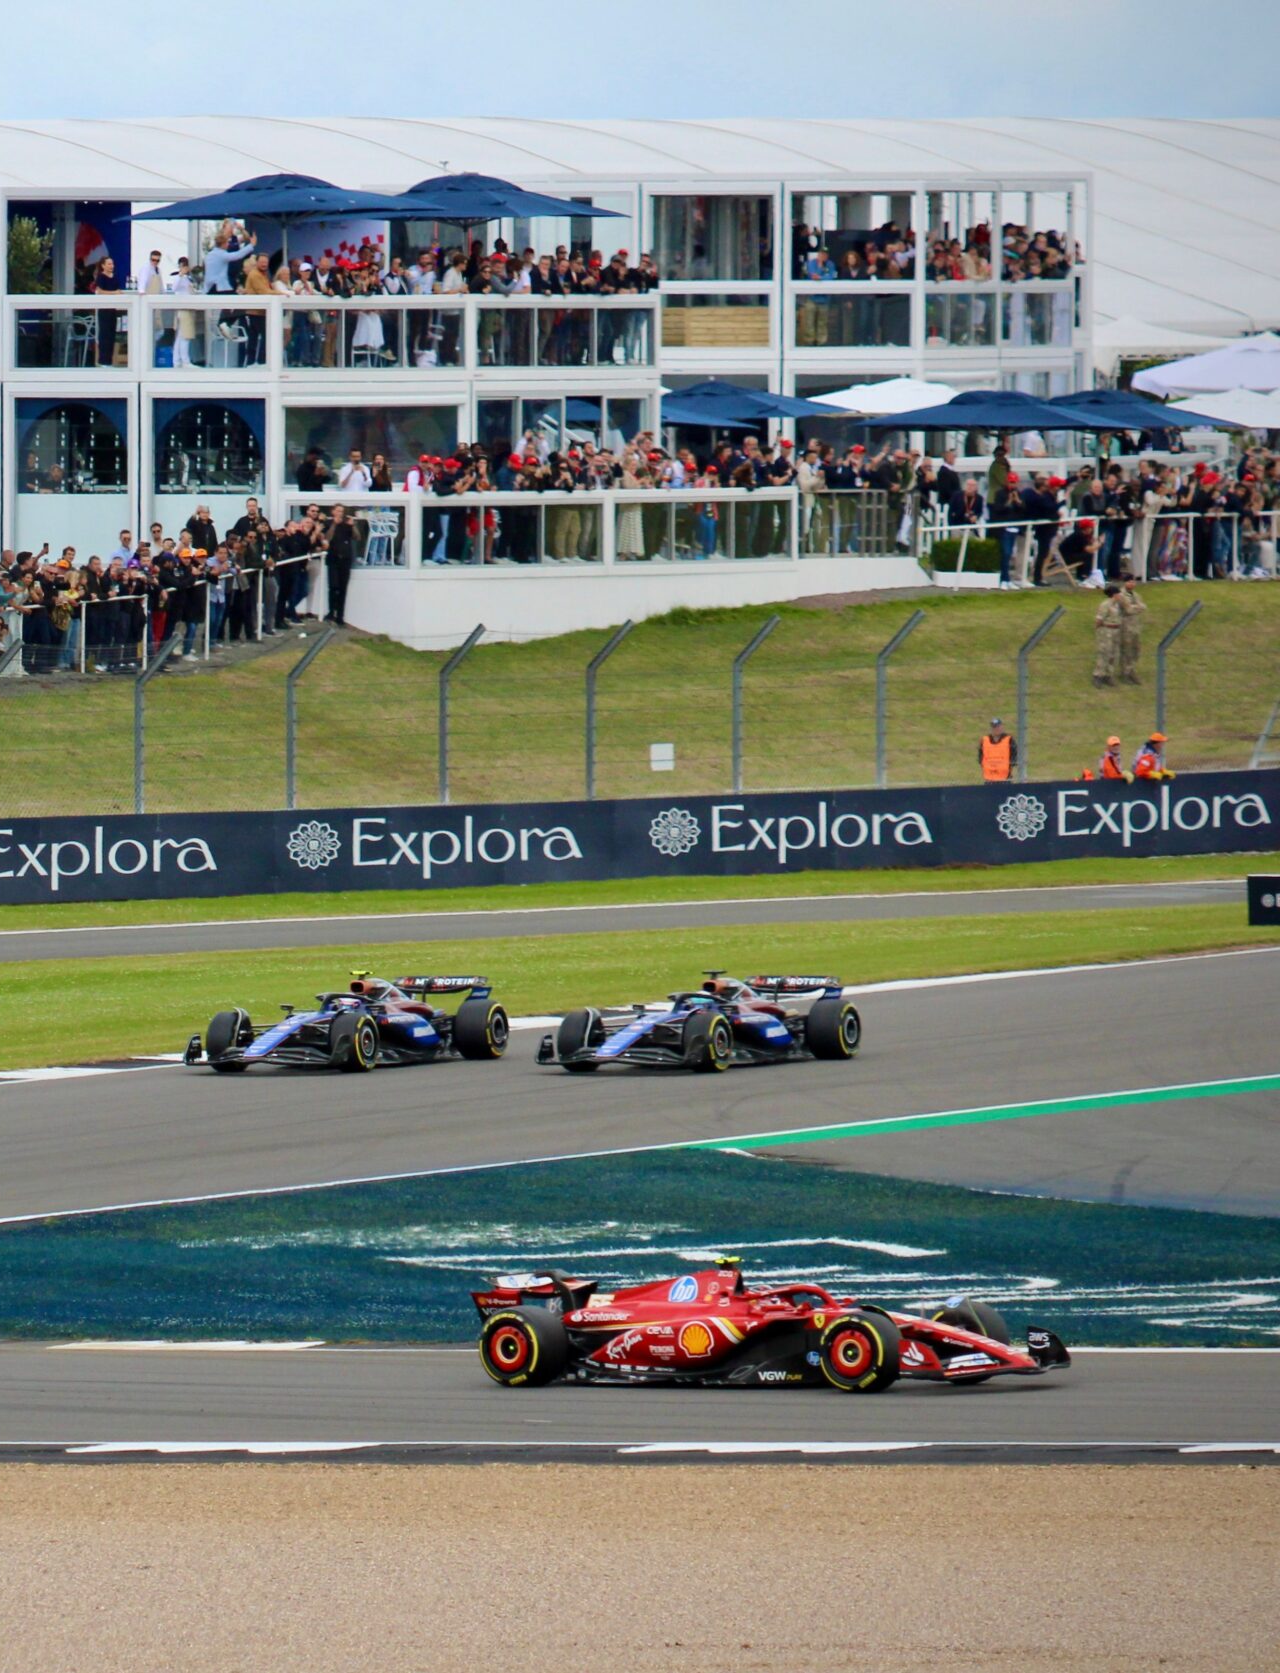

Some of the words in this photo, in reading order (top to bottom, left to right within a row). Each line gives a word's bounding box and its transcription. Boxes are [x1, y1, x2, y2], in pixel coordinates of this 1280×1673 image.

[1057, 785, 1272, 847] Explora
[711, 801, 934, 864] Explora
[352, 815, 584, 880] Explora
[671, 1279, 694, 1301] hp
[583, 1311, 631, 1322] Santander
[1028, 1332, 1050, 1342] aws
[758, 1371, 787, 1381] VGW
